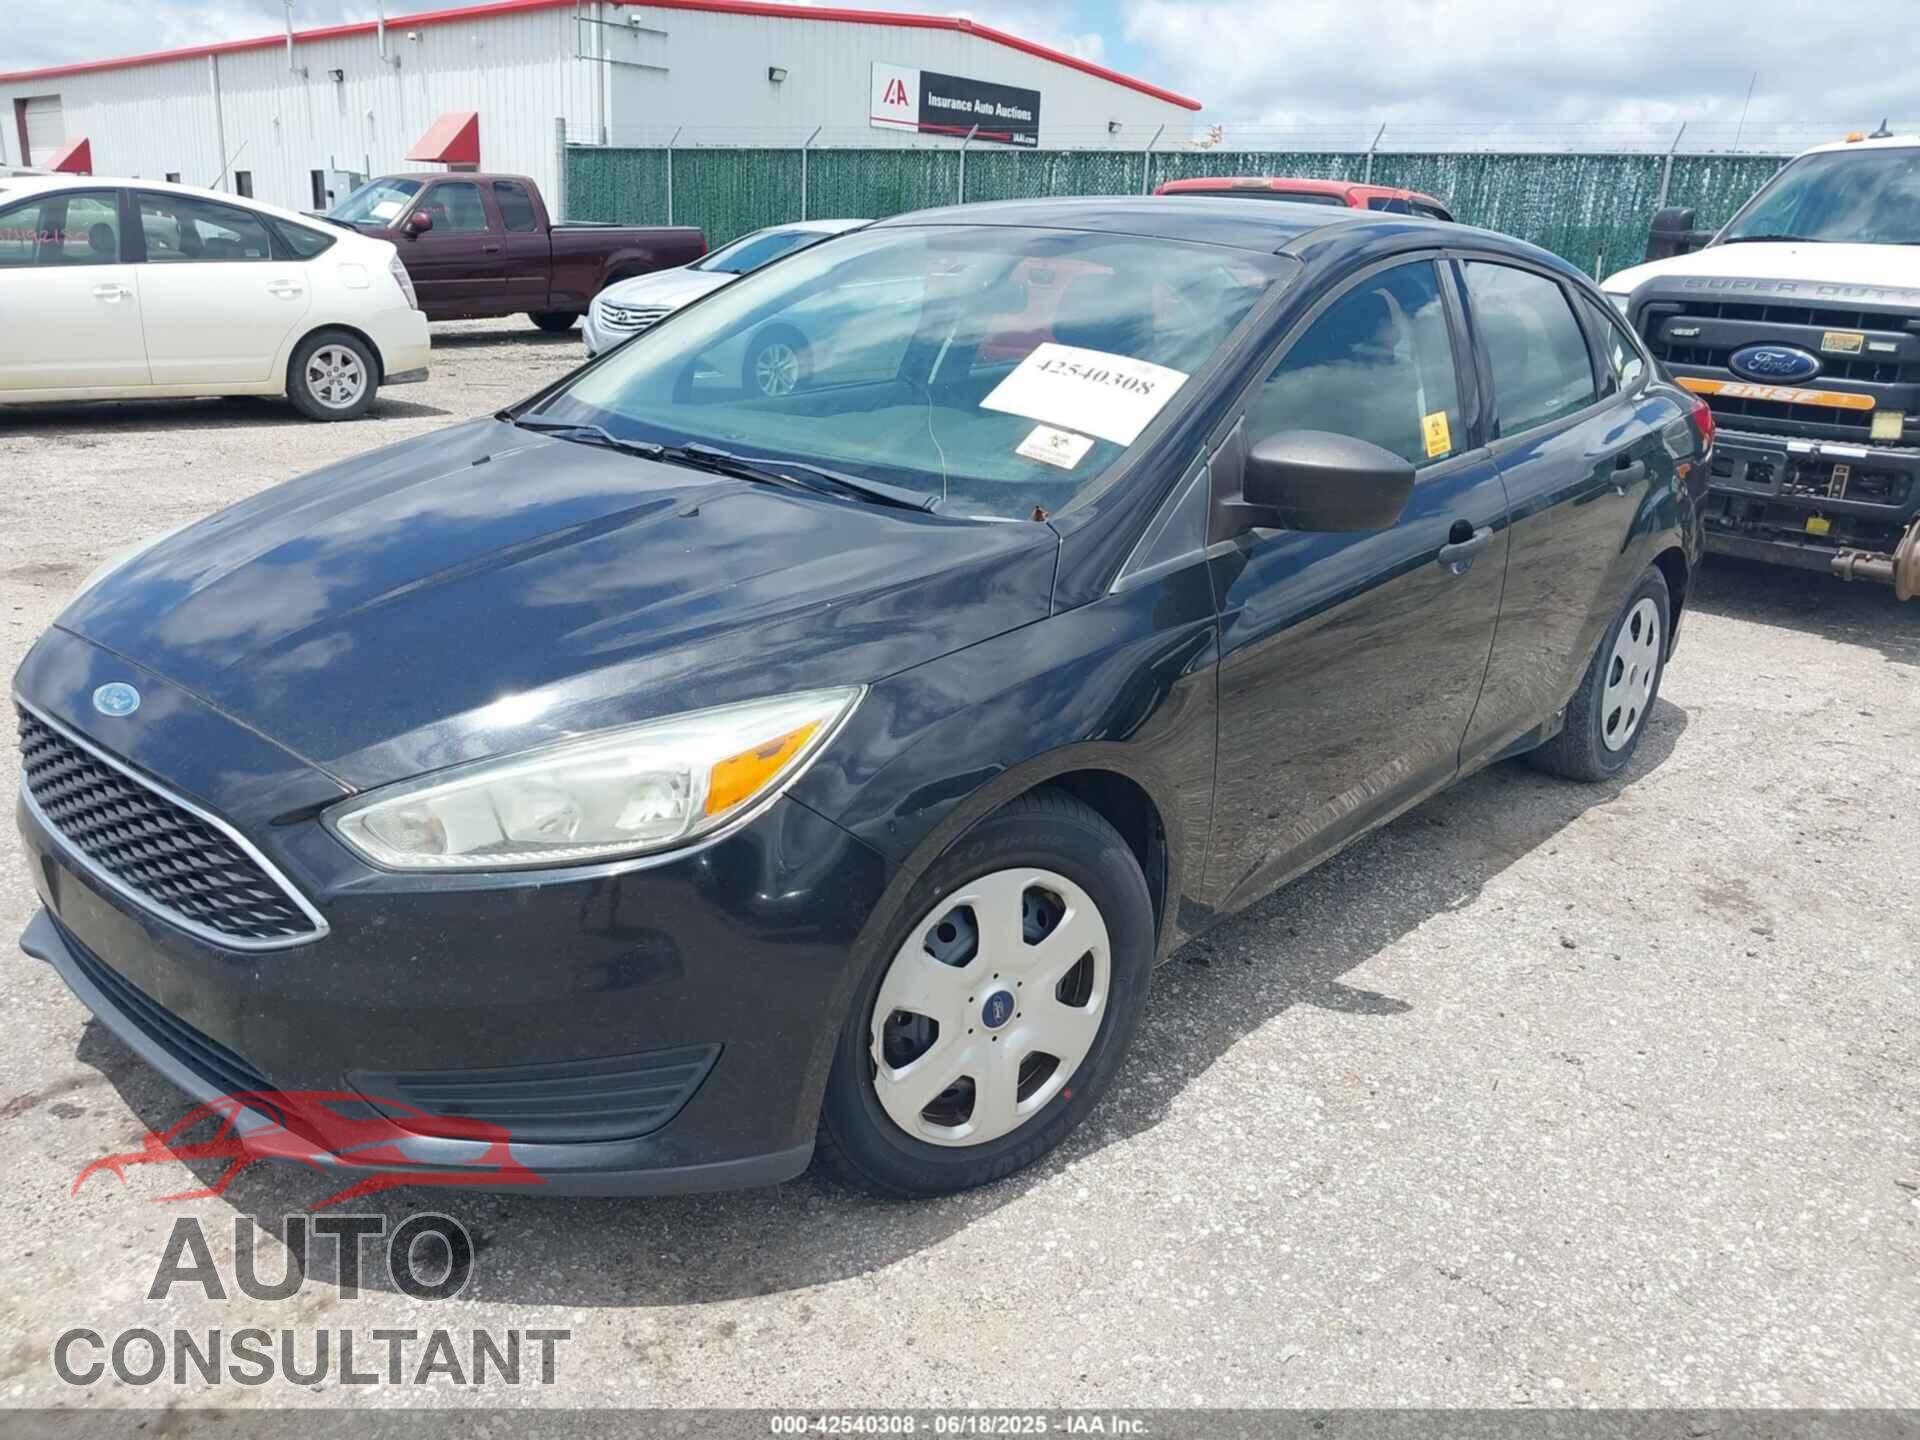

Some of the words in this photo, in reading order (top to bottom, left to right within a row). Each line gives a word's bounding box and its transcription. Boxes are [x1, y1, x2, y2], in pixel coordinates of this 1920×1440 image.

[928, 91, 973, 112] Insurance
[974, 100, 994, 116] Auto
[995, 103, 1032, 121] Auctions
[1683, 278, 1799, 293] SUPER
[1747, 351, 1798, 374] Ford
[1036, 359, 1155, 395] 42540308
[1718, 383, 1822, 402] BNSF
